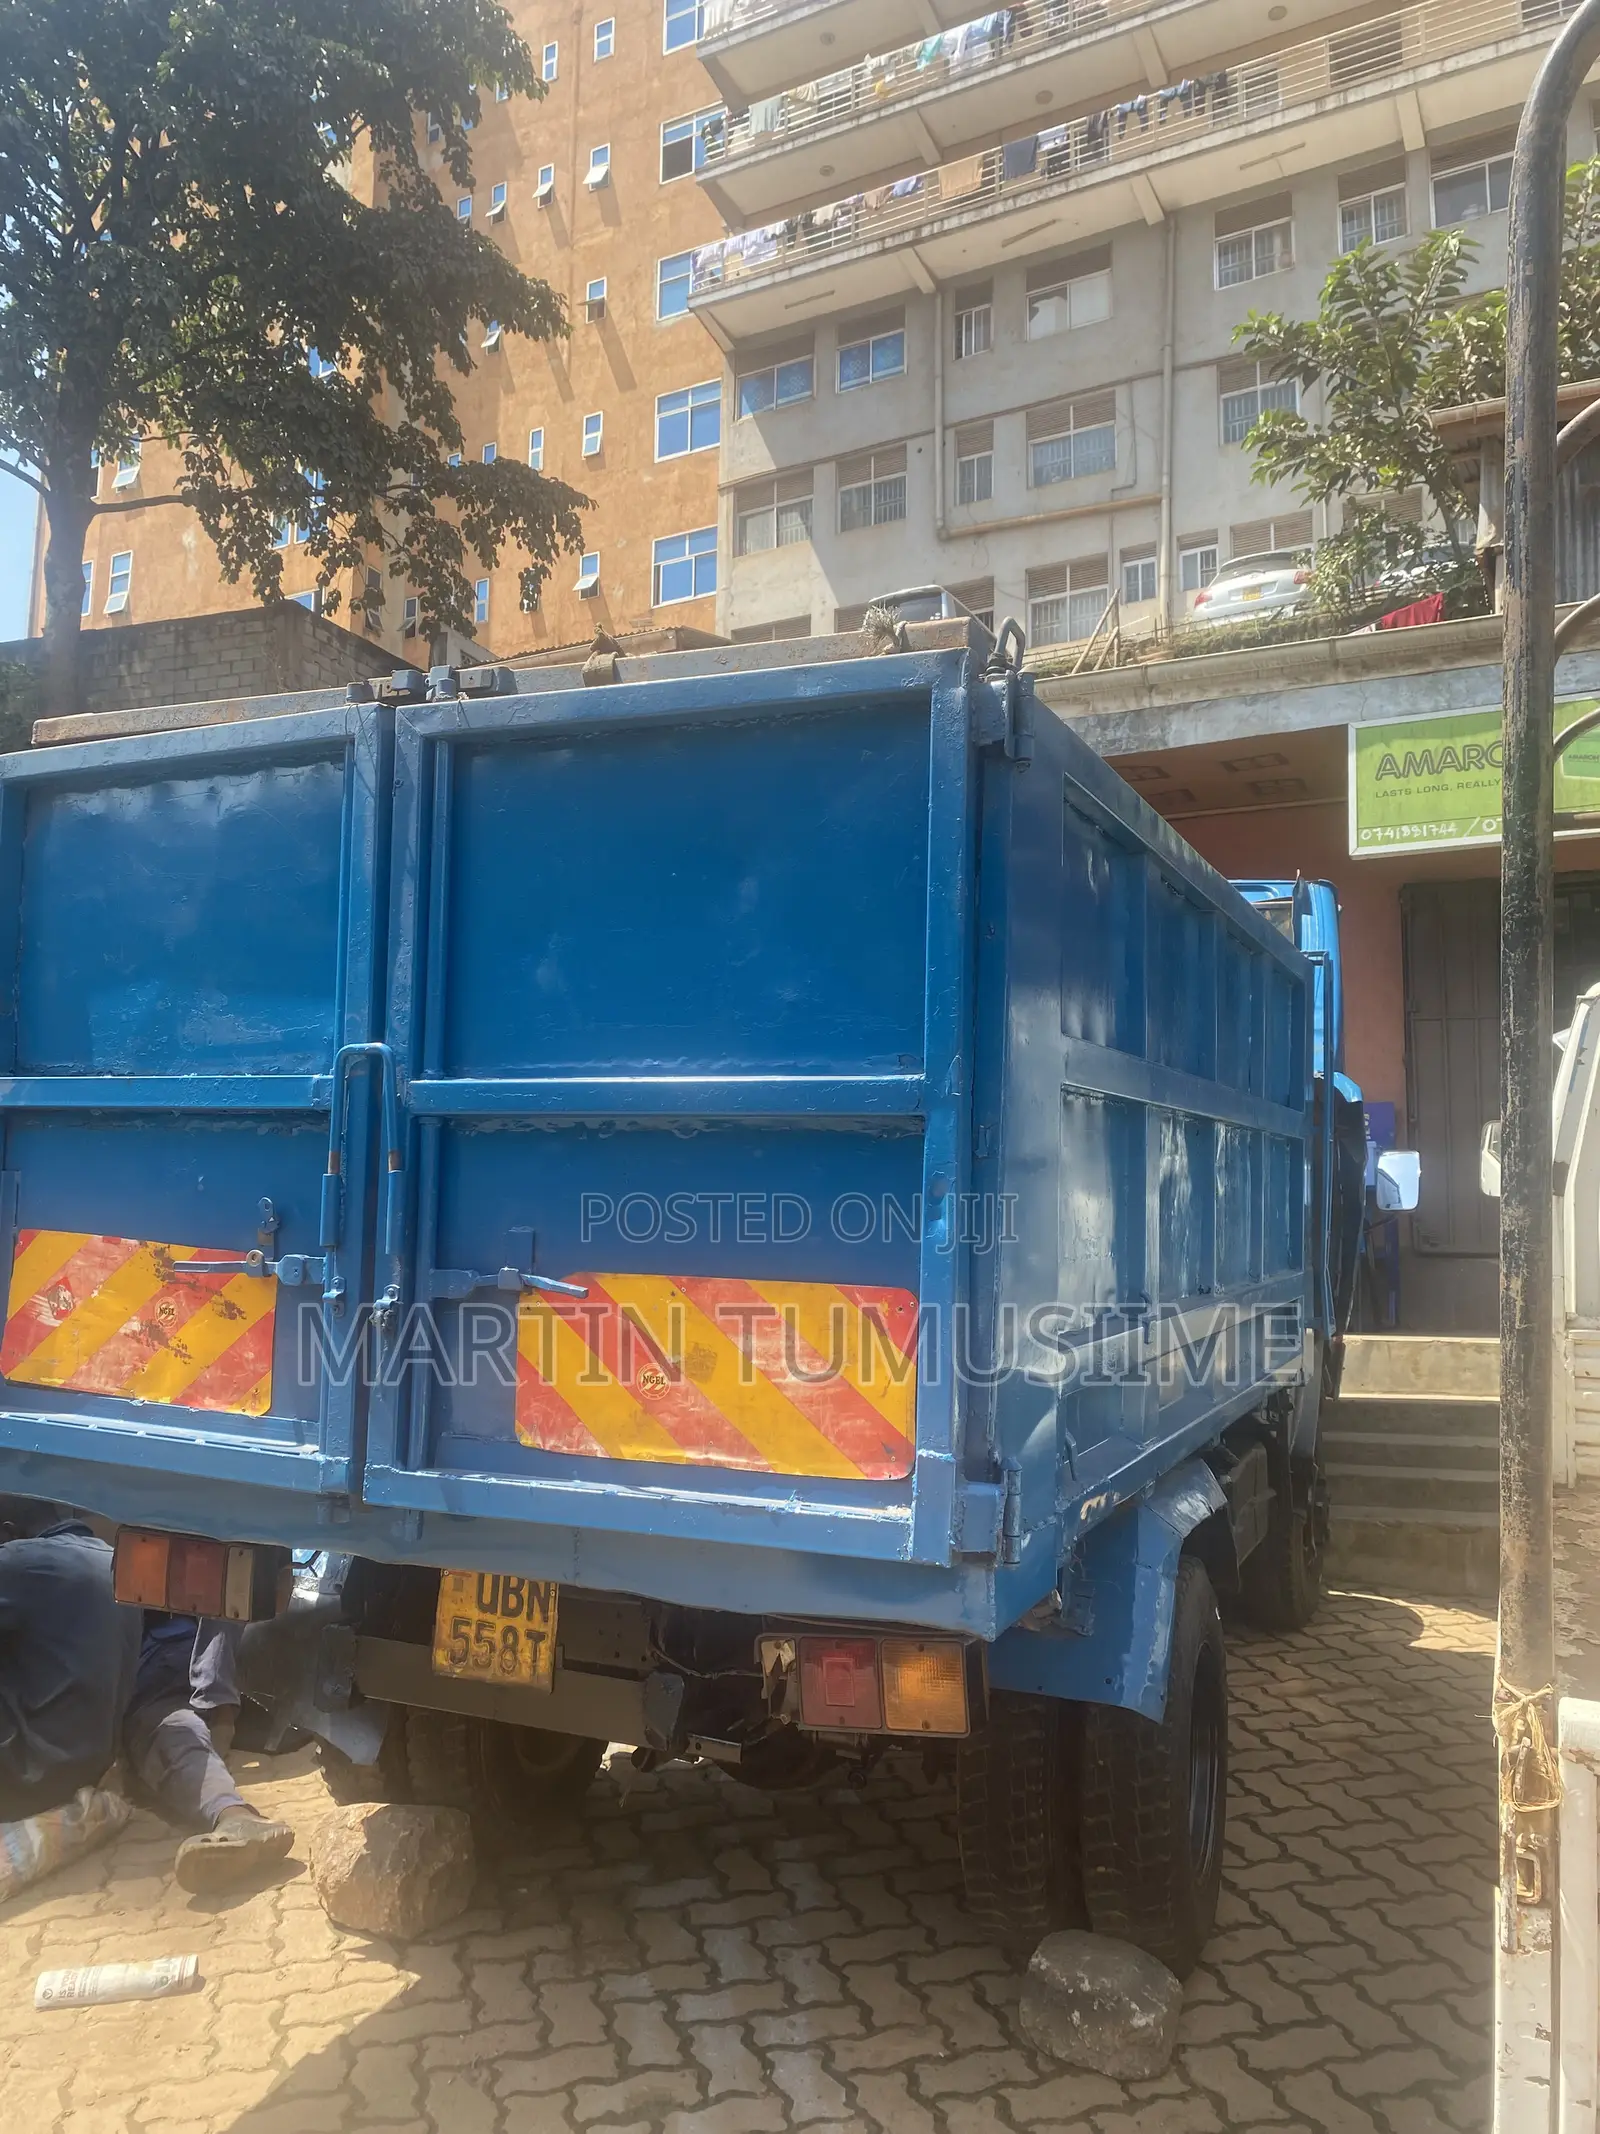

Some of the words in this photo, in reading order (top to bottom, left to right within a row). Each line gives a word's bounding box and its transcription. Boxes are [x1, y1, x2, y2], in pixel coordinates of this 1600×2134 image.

[1375, 788, 1412, 799] LASTS
[1416, 784, 1453, 794] LONG,
[1456, 778, 1502, 790] REALLY
[477, 1572, 551, 1623] UBN
[448, 1616, 548, 1676] 558T
